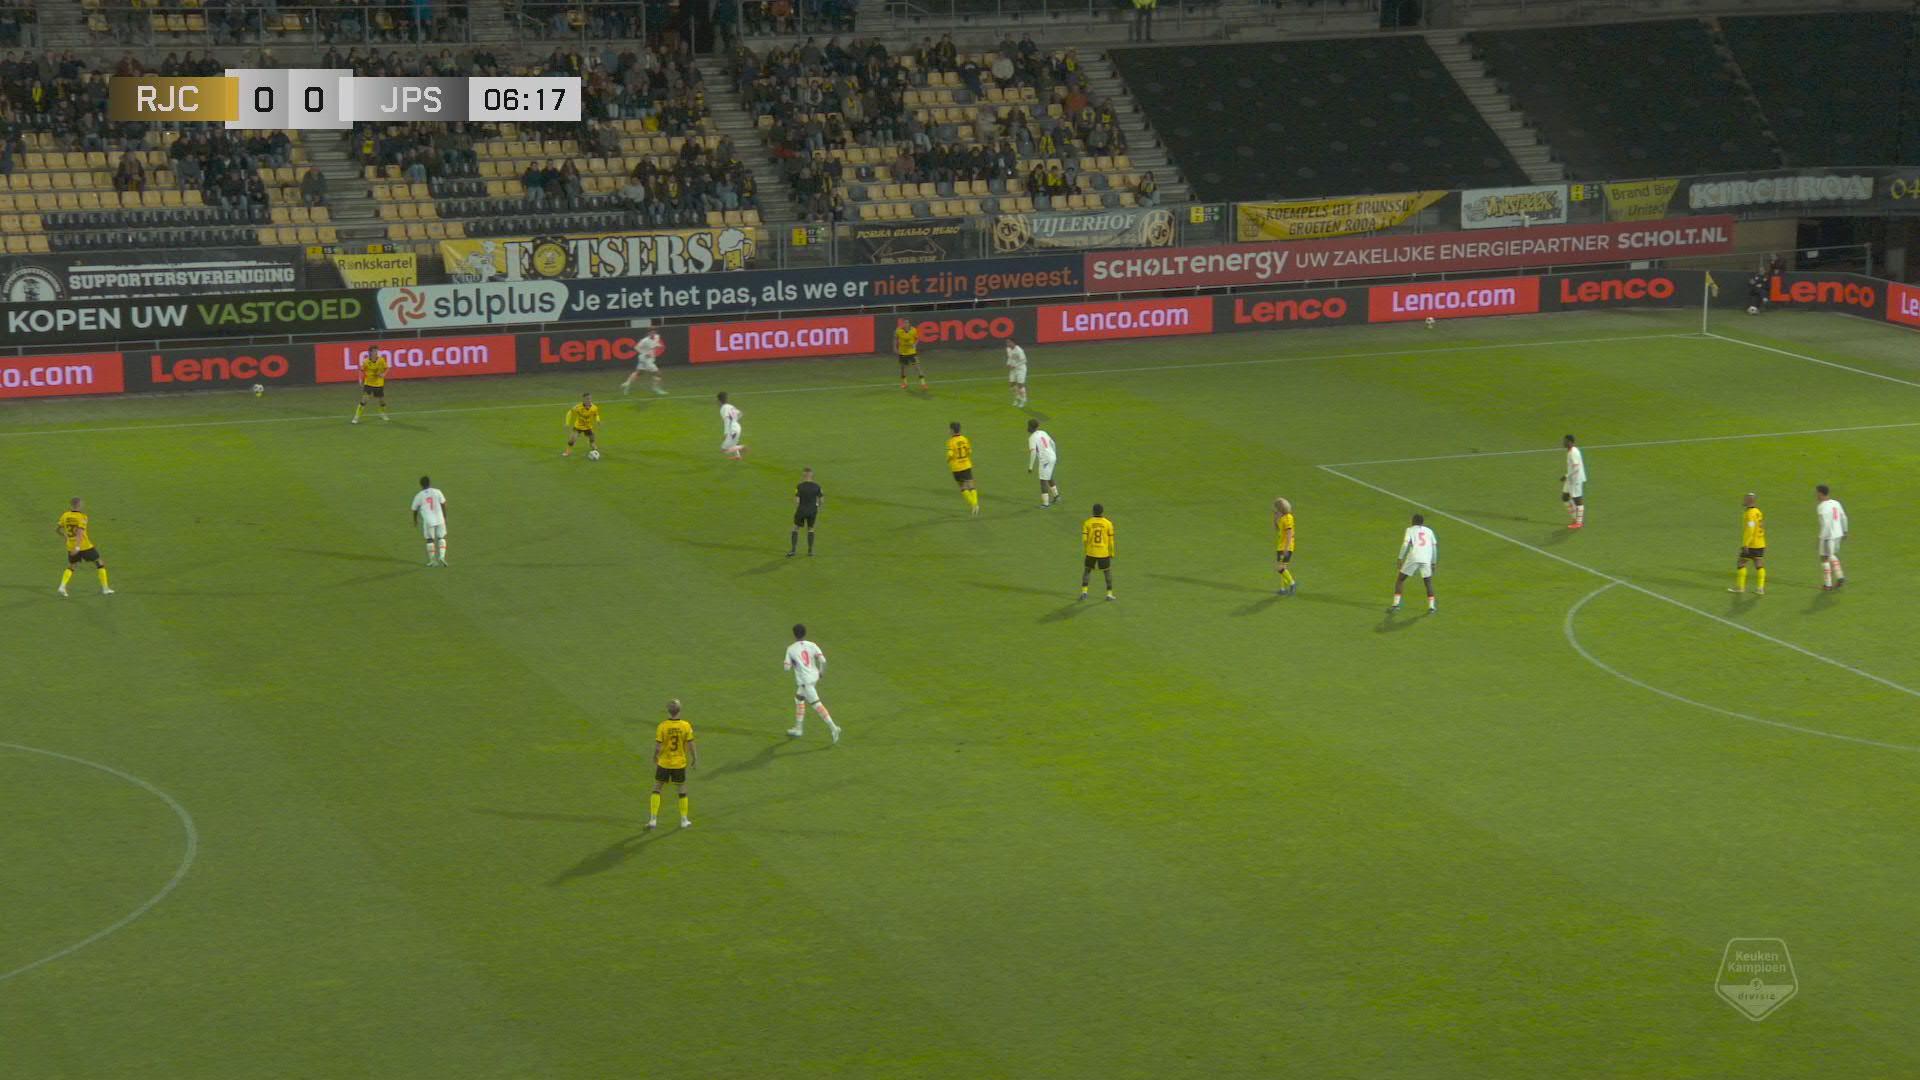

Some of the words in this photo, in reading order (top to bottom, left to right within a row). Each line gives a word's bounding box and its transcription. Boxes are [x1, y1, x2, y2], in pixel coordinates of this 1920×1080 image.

[1033, 215, 1137, 236] VIJLERHOF
[1295, 251, 1330, 269] UW
[1333, 245, 1434, 267] ZAKELIJKE
[1440, 234, 1609, 260] ENERGIEPARTNER
[1618, 226, 1728, 250] SCHOLT.NL
[69, 268, 295, 289] SUPPORTERSVERENIGING
[571, 290, 600, 312] Je
[606, 287, 654, 310] ziet
[660, 285, 700, 307] het
[706, 286, 757, 310] pas,
[762, 280, 797, 302] als
[803, 282, 838, 300] we
[843, 280, 869, 298] er
[874, 274, 920, 296] niet
[926, 271, 968, 297] zijn
[975, 266, 1079, 297] geweest.
[1560, 276, 1674, 303] Lenco
[1770, 275, 1875, 308] Lenco
[433, 285, 556, 323] sblplus
[1233, 296, 1347, 324] Lenco
[1392, 287, 1515, 312] Lenco.com
[8, 307, 121, 333] KOPEN
[131, 304, 189, 329] UW
[197, 297, 361, 326] VASTGOED
[1062, 305, 1189, 332] Lenco.com
[540, 337, 667, 363] Lenc
[715, 325, 848, 352] Lenco.com
[0, 365, 93, 388] o.com
[151, 353, 289, 383] Lenco
[1094, 529, 1102, 544] 8
[1418, 532, 1427, 547] 5
[670, 735, 679, 752] 3
